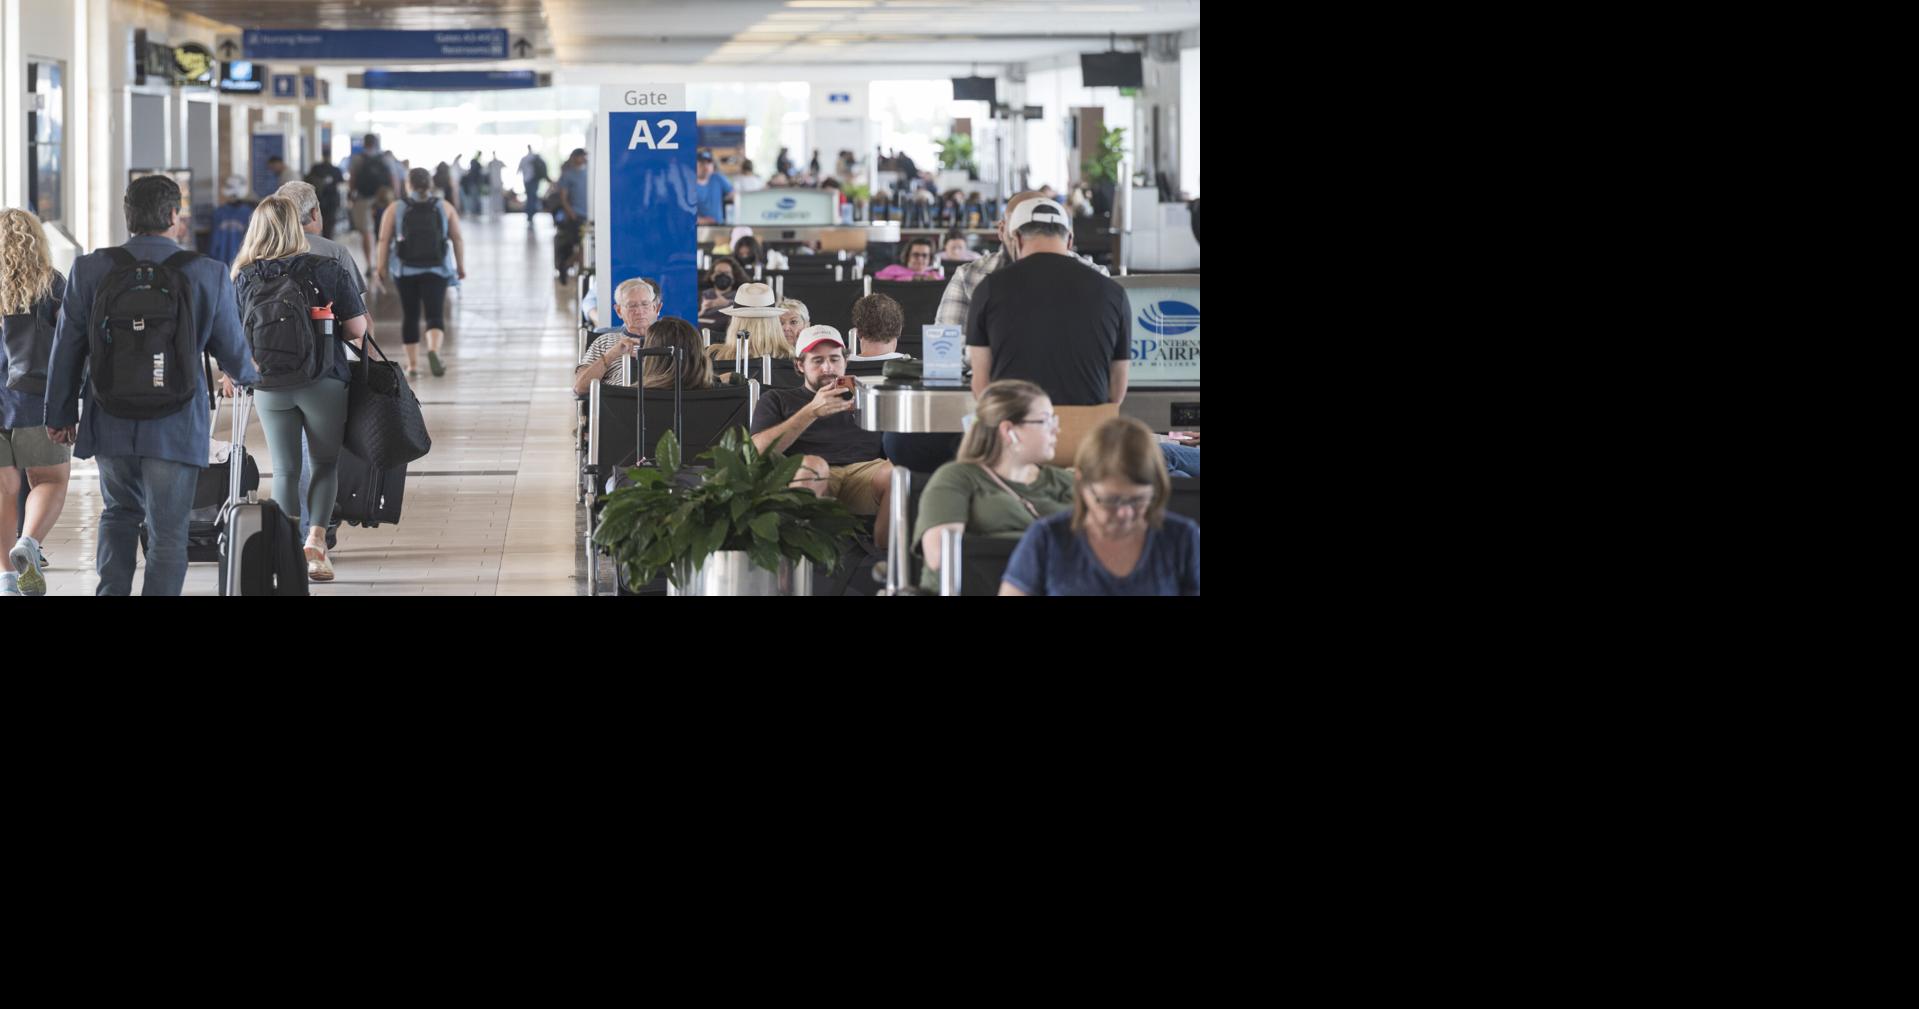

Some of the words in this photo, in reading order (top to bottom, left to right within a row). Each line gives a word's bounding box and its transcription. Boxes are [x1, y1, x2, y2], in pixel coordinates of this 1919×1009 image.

[624, 90, 667, 106] Gate
[627, 119, 679, 150] A2
[1130, 339, 1157, 360] SP
[1155, 347, 1200, 360] AIRP
[153, 352, 165, 387] THULE
